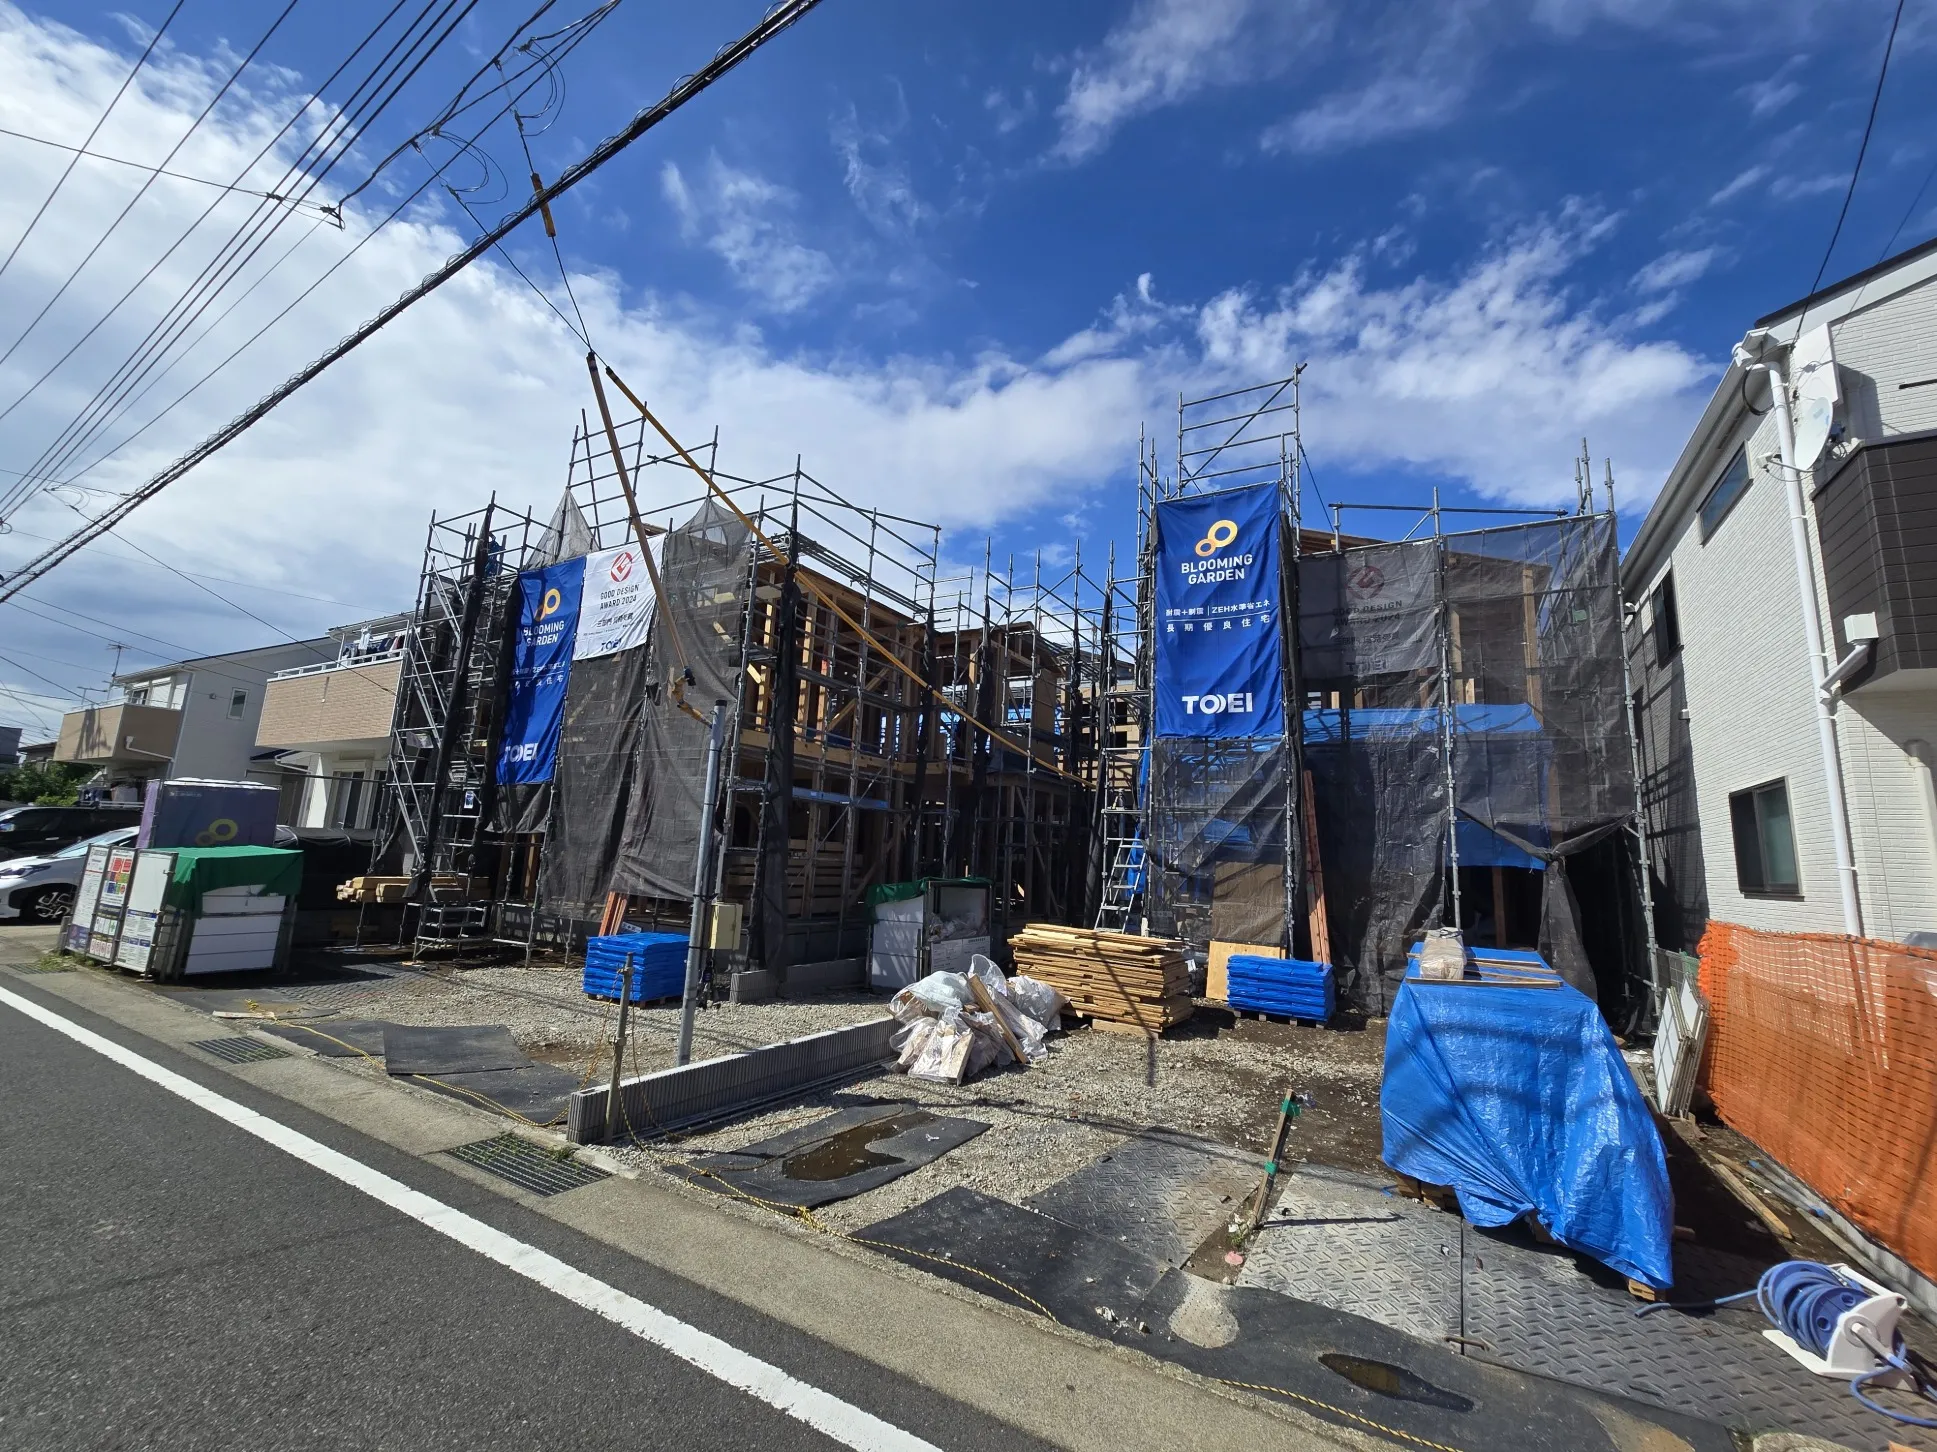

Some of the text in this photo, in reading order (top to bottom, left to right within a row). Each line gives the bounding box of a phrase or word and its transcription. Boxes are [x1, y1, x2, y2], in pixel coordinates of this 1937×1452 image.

[1181, 554, 1253, 574] BLOOMING
[1188, 568, 1245, 585] GARDEN
[600, 583, 640, 601] GOOD DESIGN
[599, 595, 637, 610] AWARD 2024
[1362, 600, 1403, 612] DESIGN
[1181, 692, 1253, 715] TOEI
